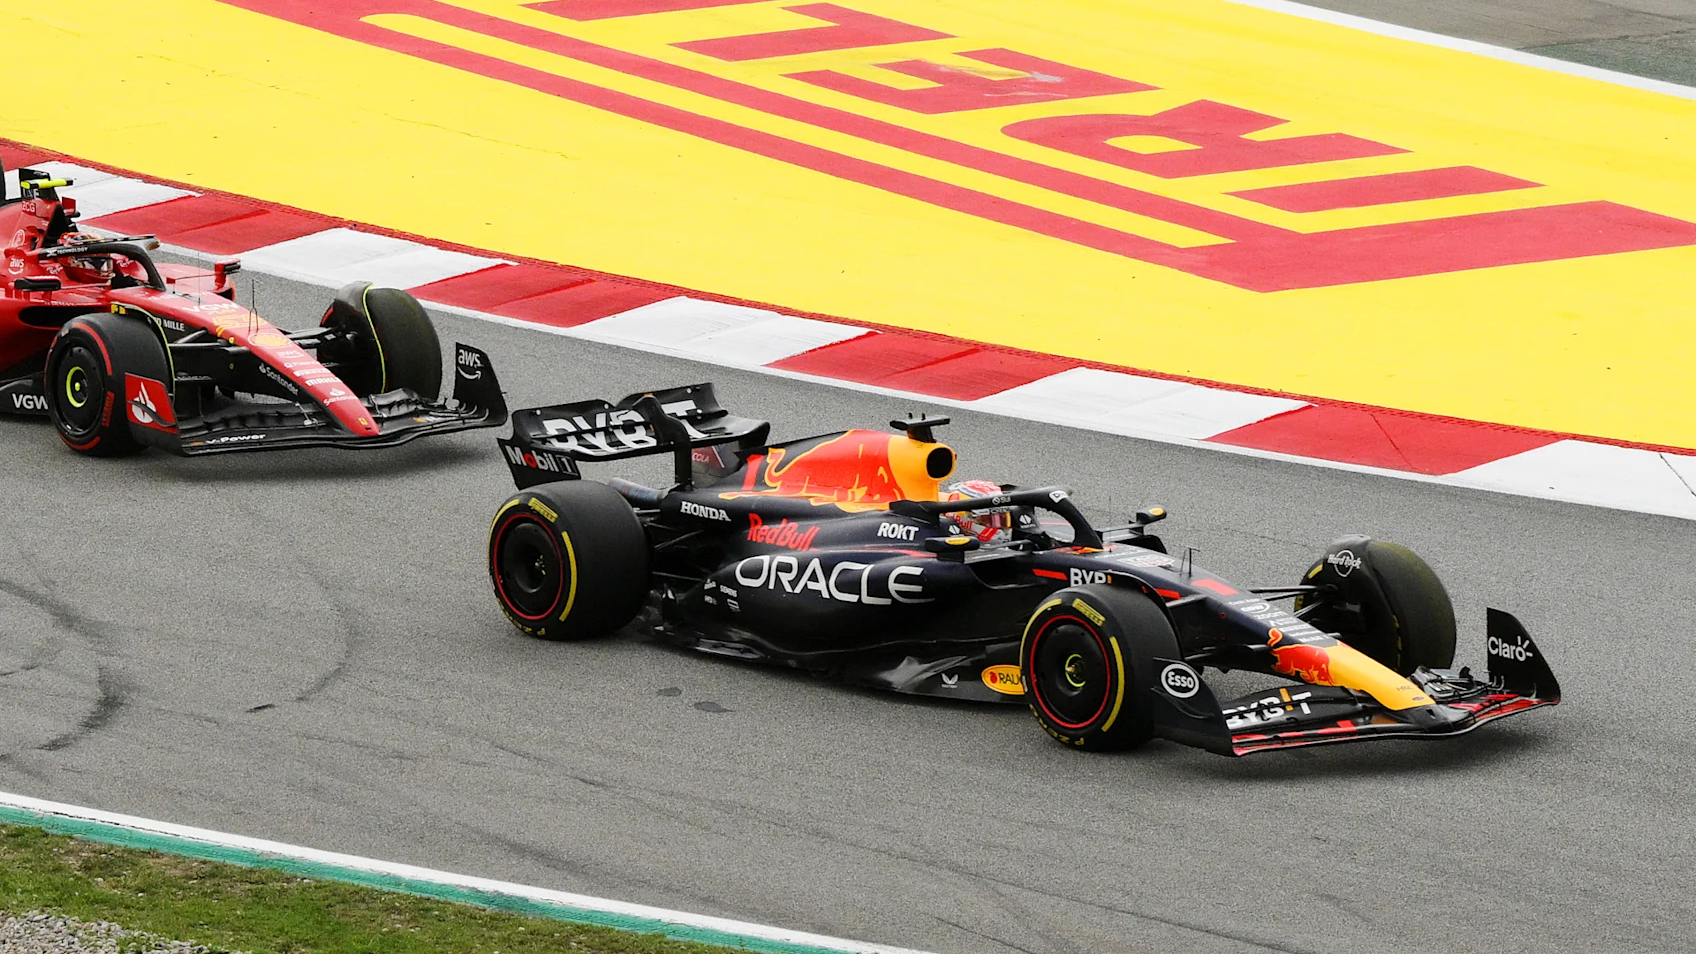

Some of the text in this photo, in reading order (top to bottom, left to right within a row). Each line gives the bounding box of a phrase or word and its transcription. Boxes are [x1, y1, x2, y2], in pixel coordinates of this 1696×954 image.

[10, 258, 24, 268] aws
[163, 319, 185, 332] MILLE
[458, 349, 481, 367] aws
[265, 366, 299, 396] Santander
[542, 399, 709, 456] BYBT
[206, 434, 266, 445] V-Power
[505, 445, 559, 473] Mobil
[680, 501, 731, 523] HONDA
[877, 522, 920, 541] ROKT
[735, 555, 936, 606] ORACLE
[1069, 567, 1112, 587] BYBI
[1488, 636, 1533, 662] Claro
[999, 672, 1022, 686] RAU
[1167, 671, 1195, 689] Esso
